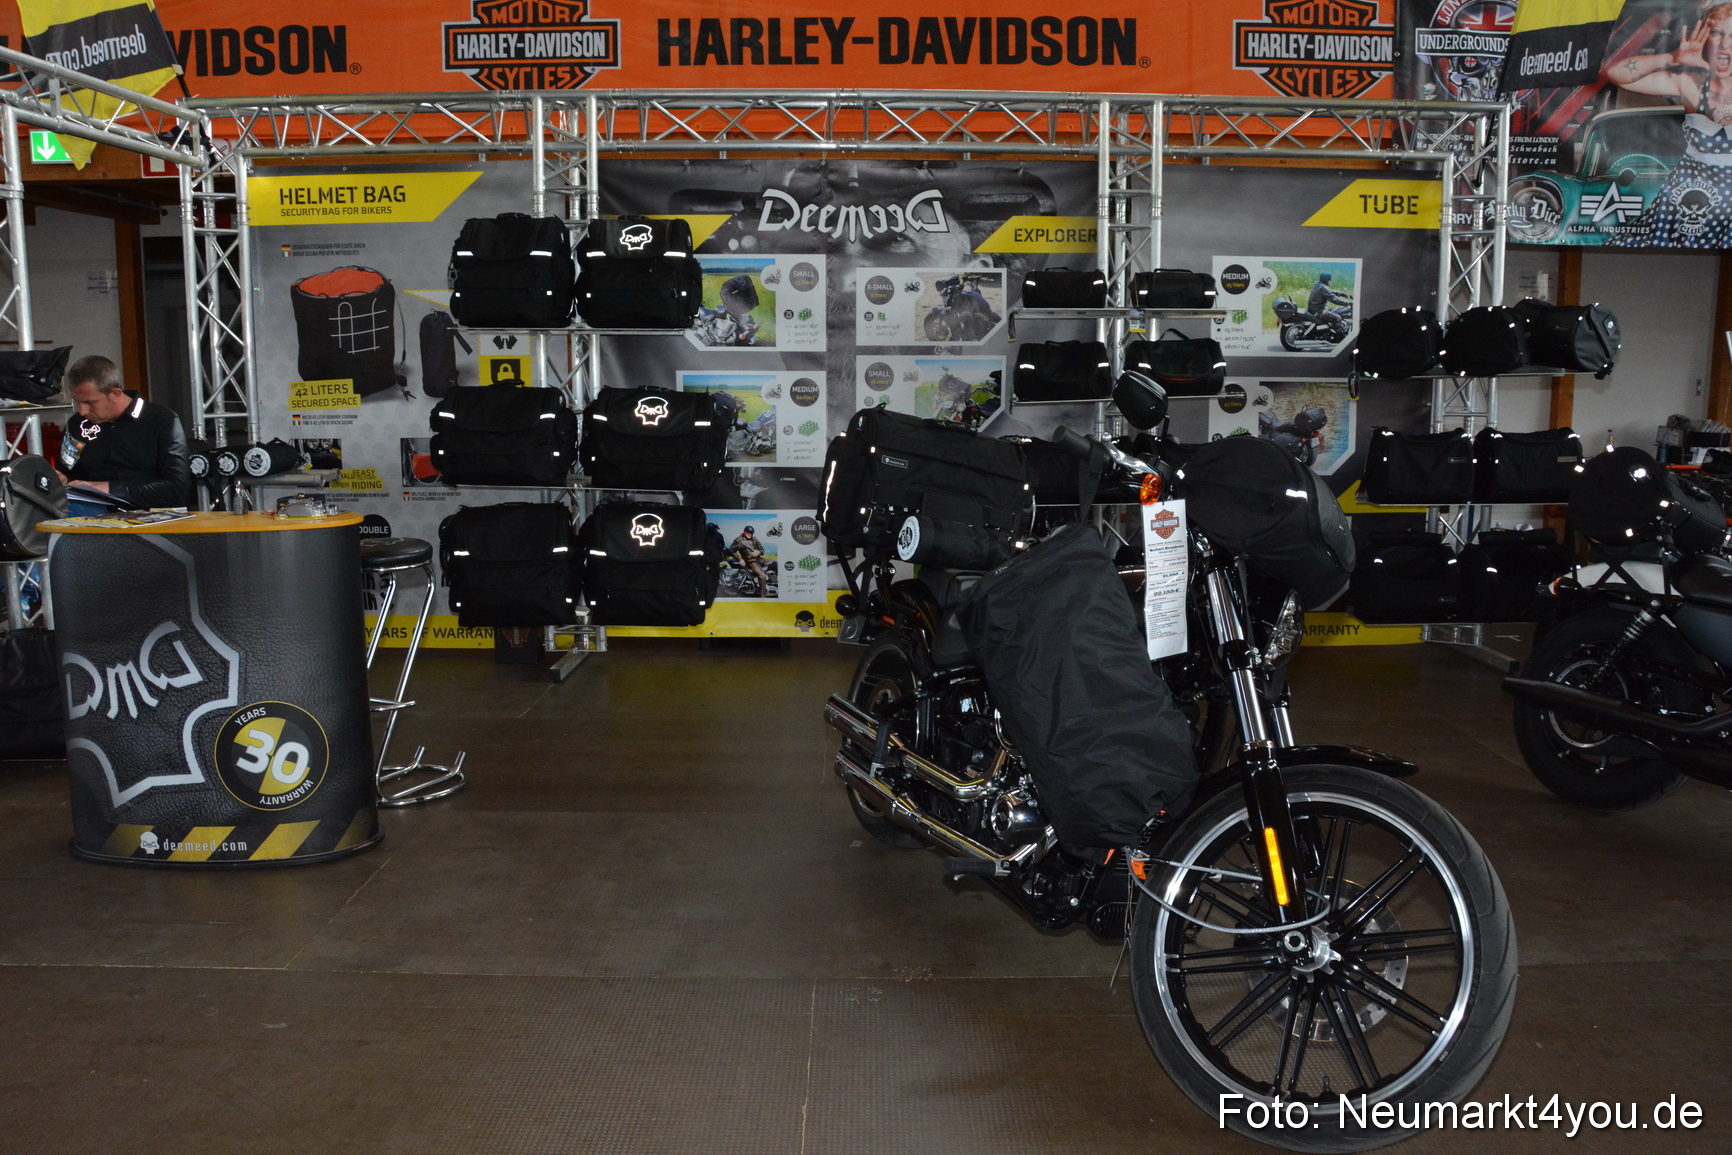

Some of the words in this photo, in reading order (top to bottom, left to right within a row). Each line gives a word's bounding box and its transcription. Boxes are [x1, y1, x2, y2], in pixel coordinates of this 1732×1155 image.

[490, 0, 572, 24] MOTOR
[1283, 0, 1360, 27] MOTOR
[457, 30, 606, 60] HARLEY-DAVIDSON
[658, 15, 1137, 67] HARLEY-DAVIDSON
[1248, 32, 1393, 62] HARLEY-DAVIDSON
[494, 67, 573, 90] CYCLES
[1281, 67, 1359, 98] CYCLES
[279, 186, 358, 205] HELMET
[363, 185, 406, 203] BAG
[1359, 194, 1419, 215] TUBE
[280, 208, 322, 217] SECURITY
[322, 207, 341, 216] BAG
[342, 206, 359, 215] FOR
[361, 206, 392, 215] BIKERS
[1530, 196, 1561, 225] Dice
[1014, 227, 1098, 243] EXPLORER
[1567, 225, 1596, 233] ALPHA
[1600, 225, 1650, 234] INDUSTRIES
[1680, 224, 1705, 235] CLUB
[793, 270, 815, 278] SMALL
[295, 388, 308, 398] 42
[310, 383, 349, 396] LITERS
[291, 399, 330, 409] SECURED
[331, 397, 358, 406] SPACE
[356, 469, 376, 477] EASY
[351, 481, 382, 490] RIDING
[365, 627, 408, 639] YARS
[235, 707, 266, 727] YEARS
[235, 728, 310, 785] 30
[259, 779, 314, 805] WARRANTY
[163, 839, 247, 853] deemeed.com
